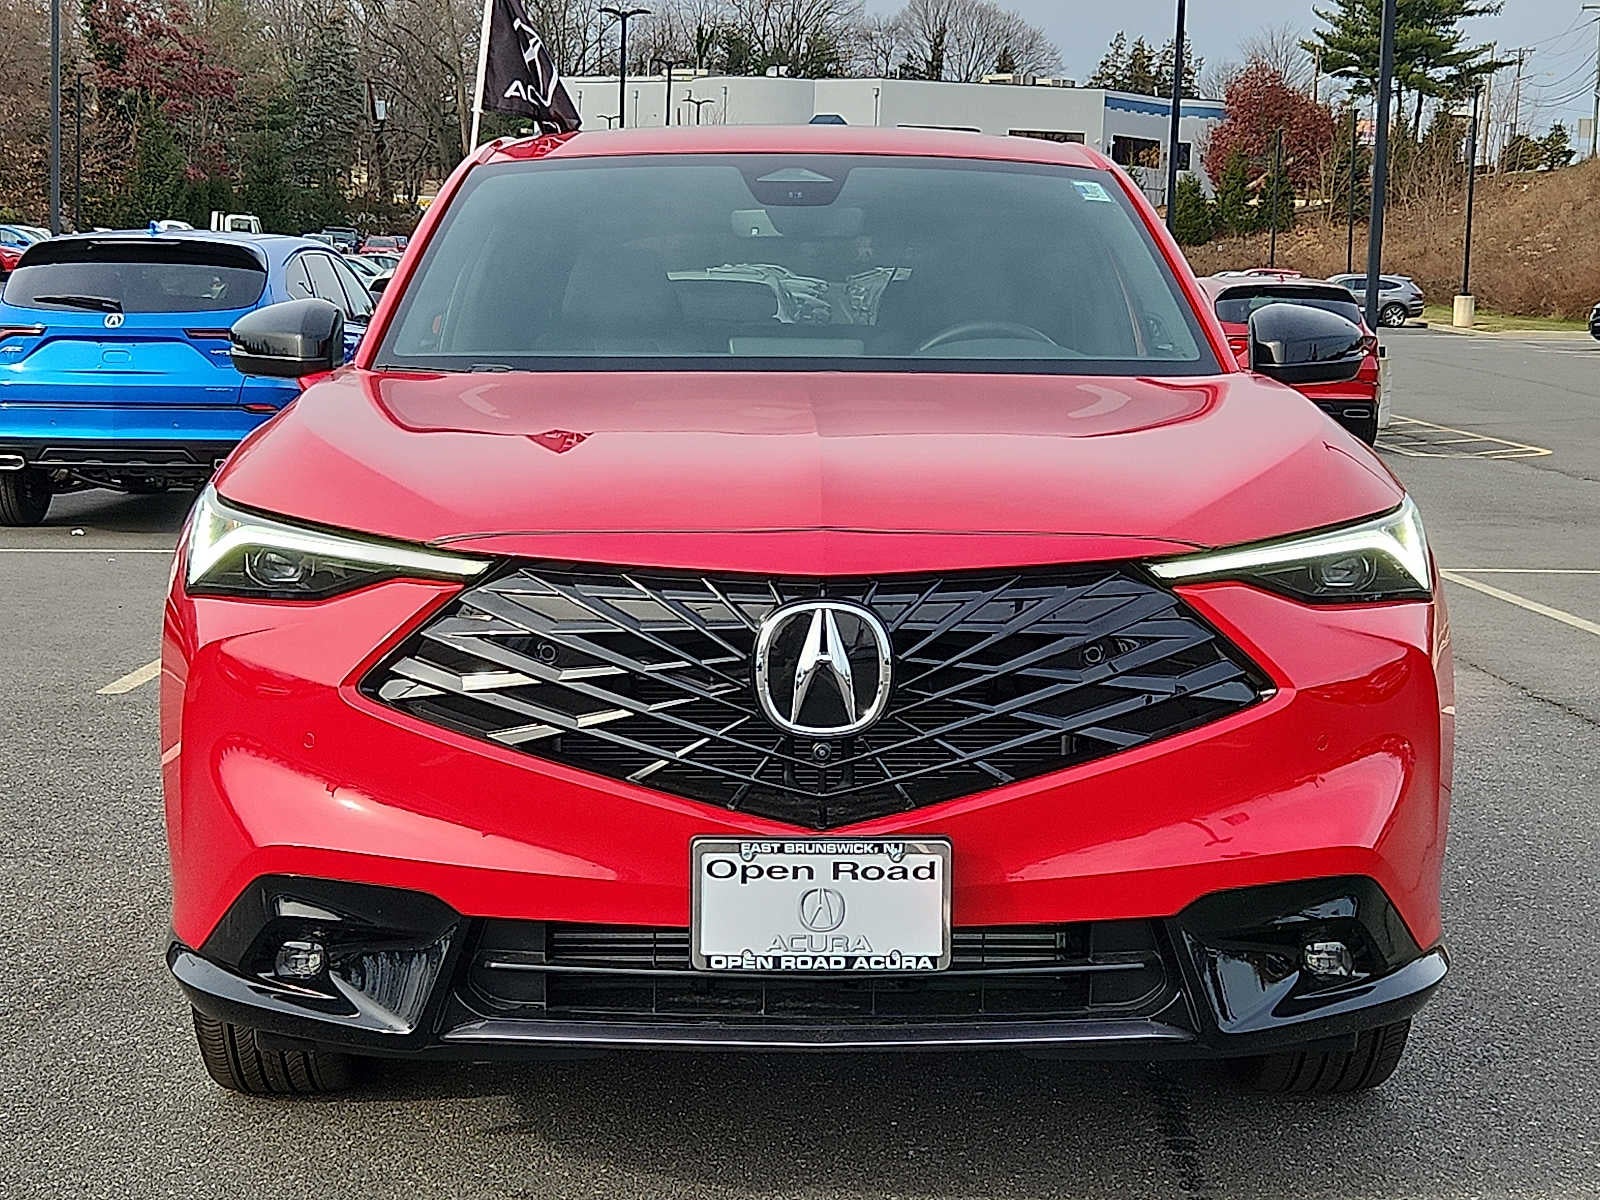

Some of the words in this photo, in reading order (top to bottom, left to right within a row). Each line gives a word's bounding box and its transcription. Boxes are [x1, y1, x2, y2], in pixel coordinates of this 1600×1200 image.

[741, 843, 780, 854] EAST
[787, 843, 878, 854] BRUNSWICK,
[706, 859, 814, 884] Open
[832, 861, 936, 880] Road
[766, 934, 873, 953] ACURA
[711, 955, 773, 970] OPEN
[781, 955, 846, 970] ROAD
[852, 955, 934, 970] ACURA
